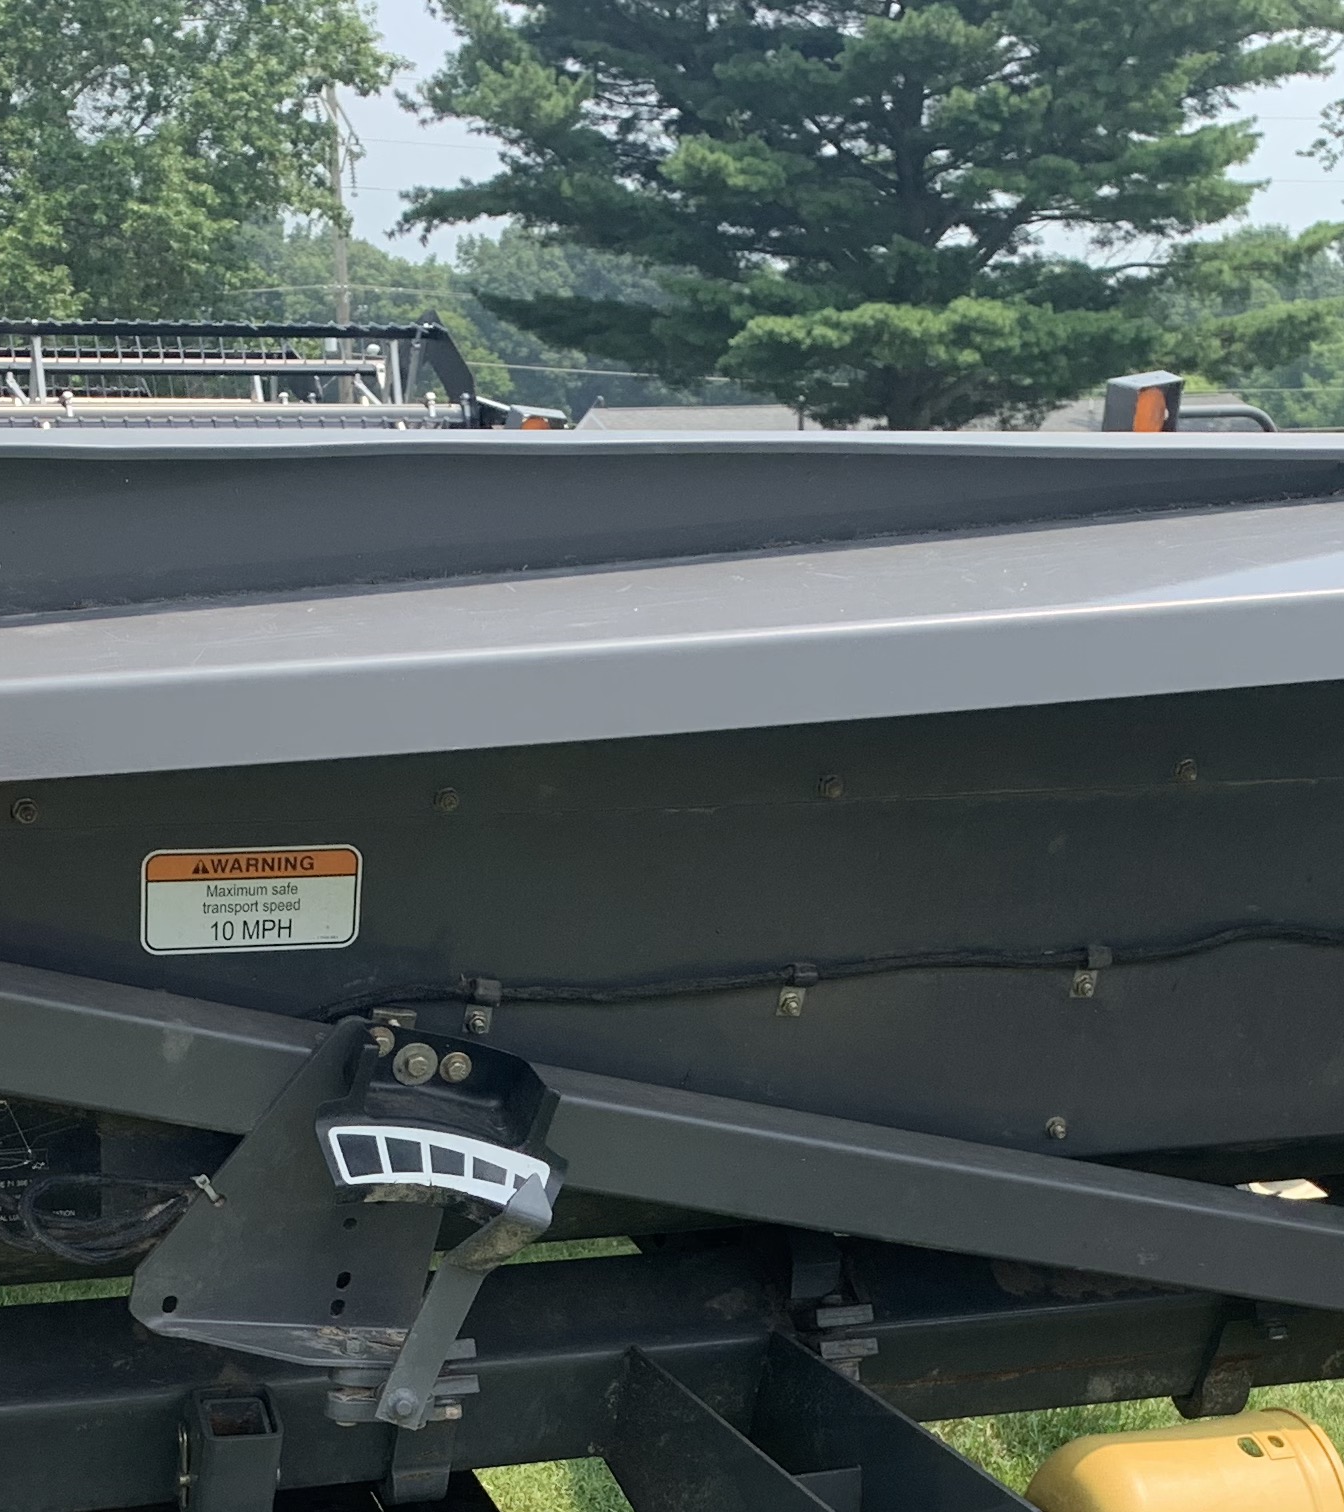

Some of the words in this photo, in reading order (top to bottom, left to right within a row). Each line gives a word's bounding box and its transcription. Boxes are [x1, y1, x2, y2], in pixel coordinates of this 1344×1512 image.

[210, 855, 315, 874] WARNING
[206, 883, 268, 898] Maximum
[272, 881, 298, 896] safe
[203, 900, 259, 916] transport
[262, 898, 301, 915] speed
[210, 920, 234, 941] 10
[242, 919, 293, 940] MPH
